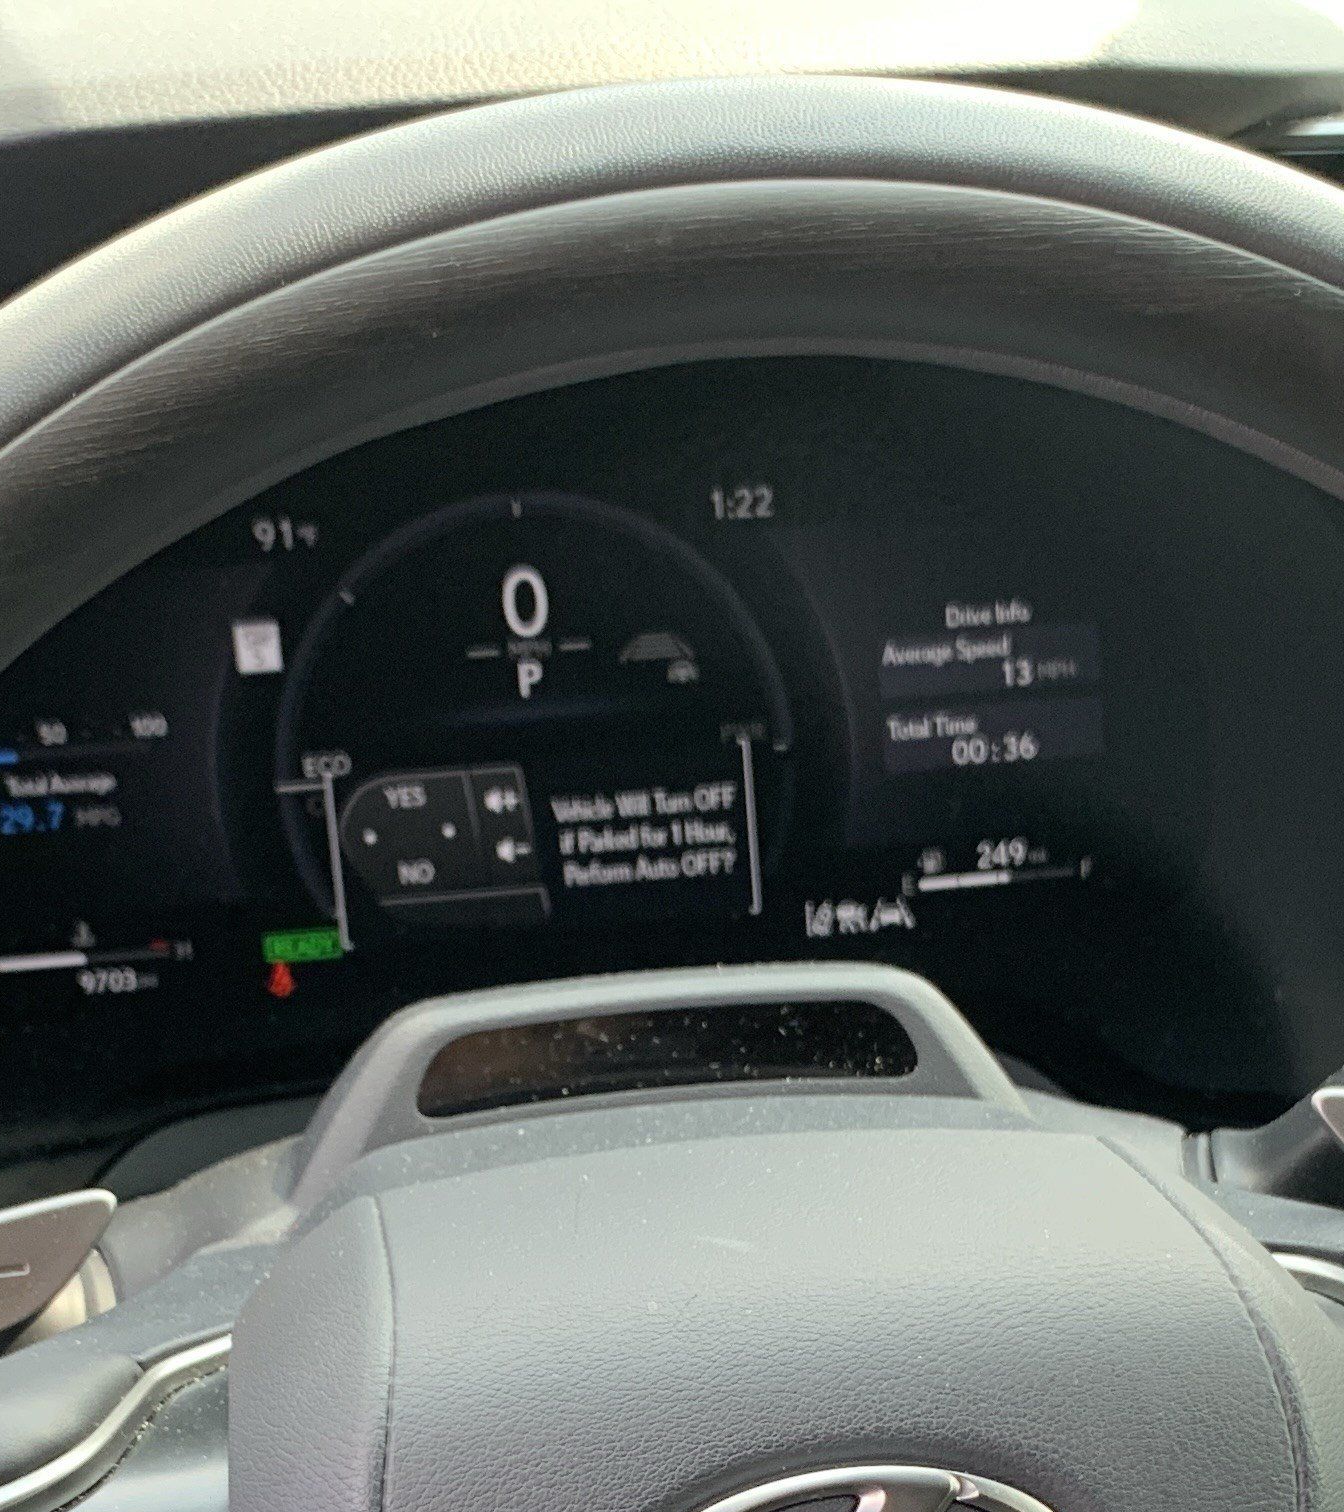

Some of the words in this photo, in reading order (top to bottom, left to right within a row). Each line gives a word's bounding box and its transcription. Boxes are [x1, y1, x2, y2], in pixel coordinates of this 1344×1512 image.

[709, 485, 774, 519] 1:22
[501, 564, 550, 638] 0
[944, 602, 992, 629] Drive
[517, 660, 544, 699] P
[383, 785, 428, 810] YES
[694, 781, 737, 812] OFF
[397, 860, 436, 886] NO
